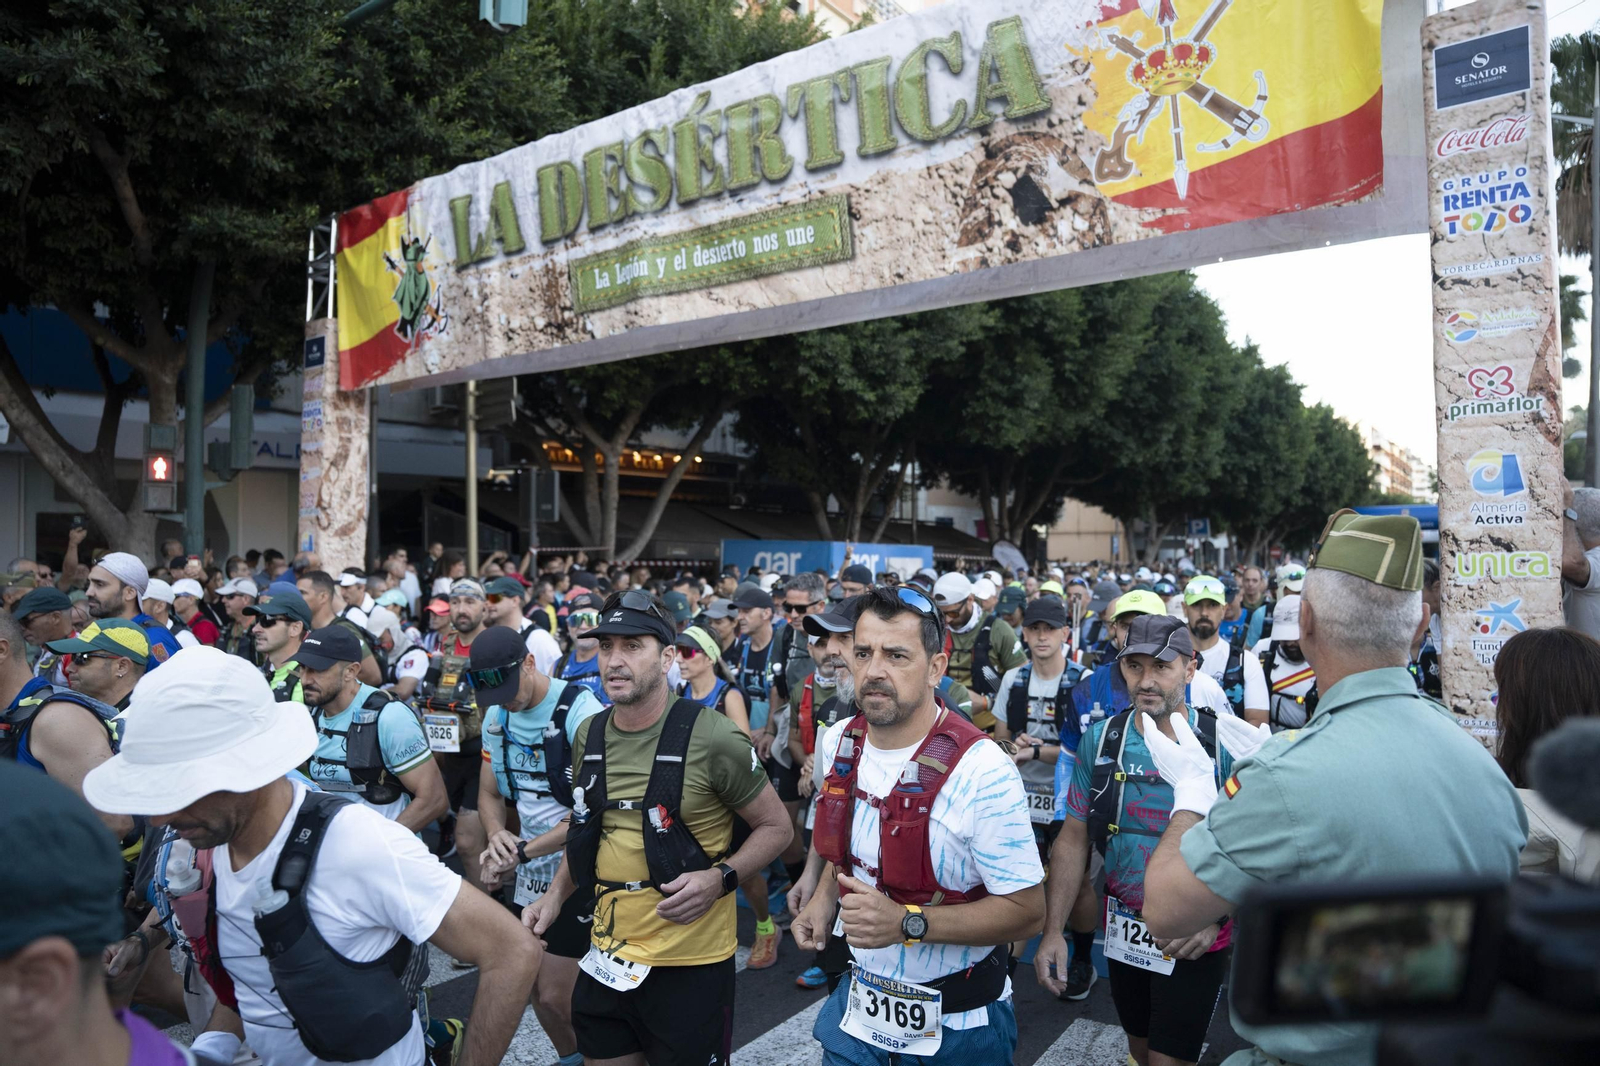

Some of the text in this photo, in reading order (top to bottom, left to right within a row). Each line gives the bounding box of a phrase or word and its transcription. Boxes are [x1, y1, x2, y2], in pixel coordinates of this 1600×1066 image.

[1455, 65, 1508, 85] SENATOR
[449, 14, 1053, 270] LA DESÉRTICA
[1443, 167, 1527, 191] GRUPO
[1443, 181, 1531, 212] RENTA
[1443, 204, 1532, 235] TODO
[593, 225, 815, 289] La Legión y el desierto nos une
[1450, 397, 1543, 421] primaflor
[1471, 501, 1526, 513] Almería
[1475, 514, 1523, 525] Activa
[429, 727, 453, 740] 3626
[1128, 764, 1143, 776] 14
[1124, 953, 1145, 965] asisa
[863, 970, 872, 983] LA
[865, 990, 926, 1031] 3169
[871, 1032, 899, 1049] asisa
